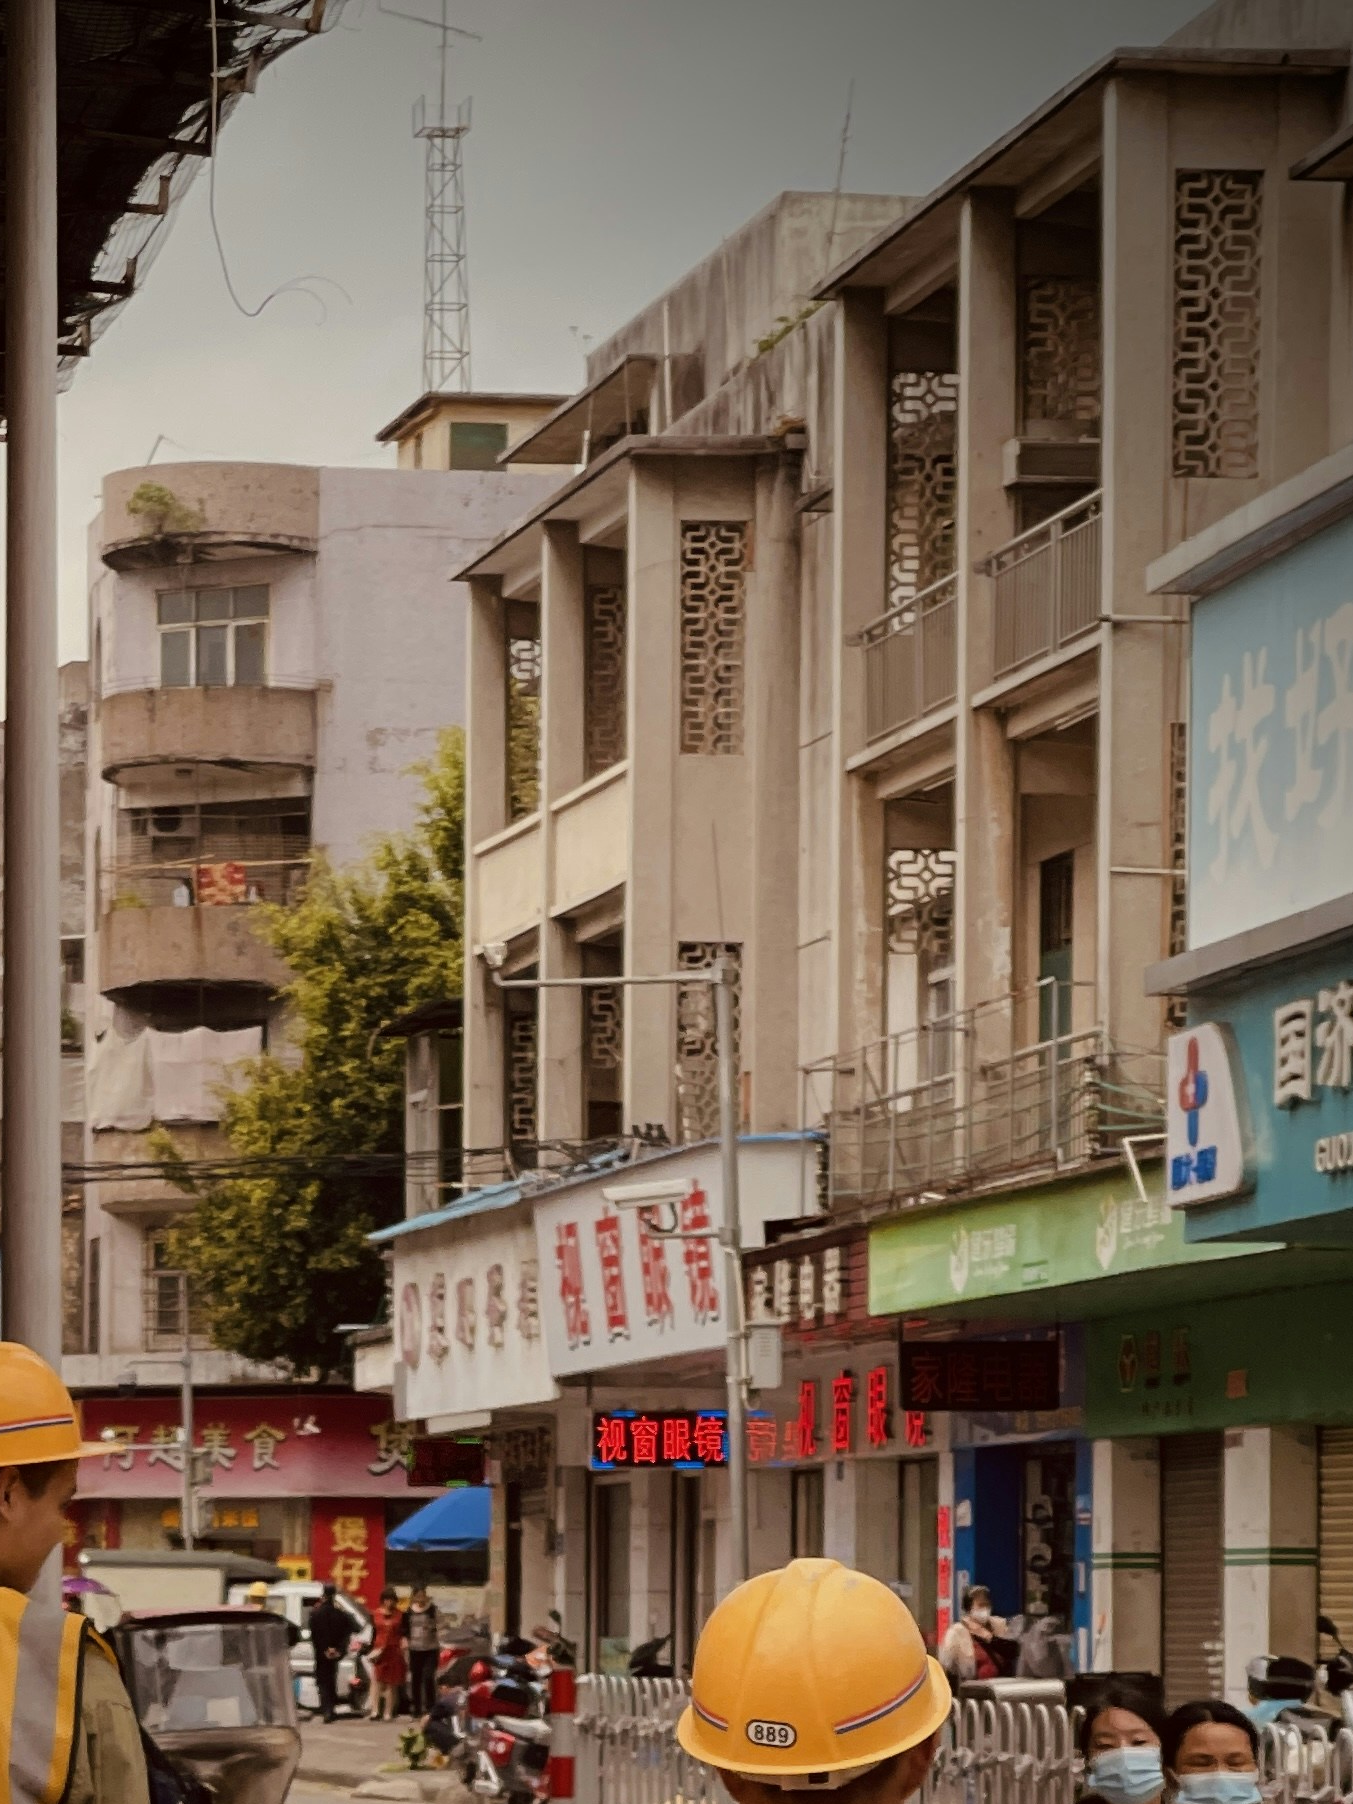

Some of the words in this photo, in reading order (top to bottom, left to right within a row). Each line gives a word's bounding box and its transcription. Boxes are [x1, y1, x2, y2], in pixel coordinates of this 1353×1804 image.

[910, 1352, 1049, 1403] 家隆电器
[596, 1416, 726, 1464] 视窗眼镜
[330, 1516, 369, 1602] 煲仔
[753, 1724, 789, 1745] 889
